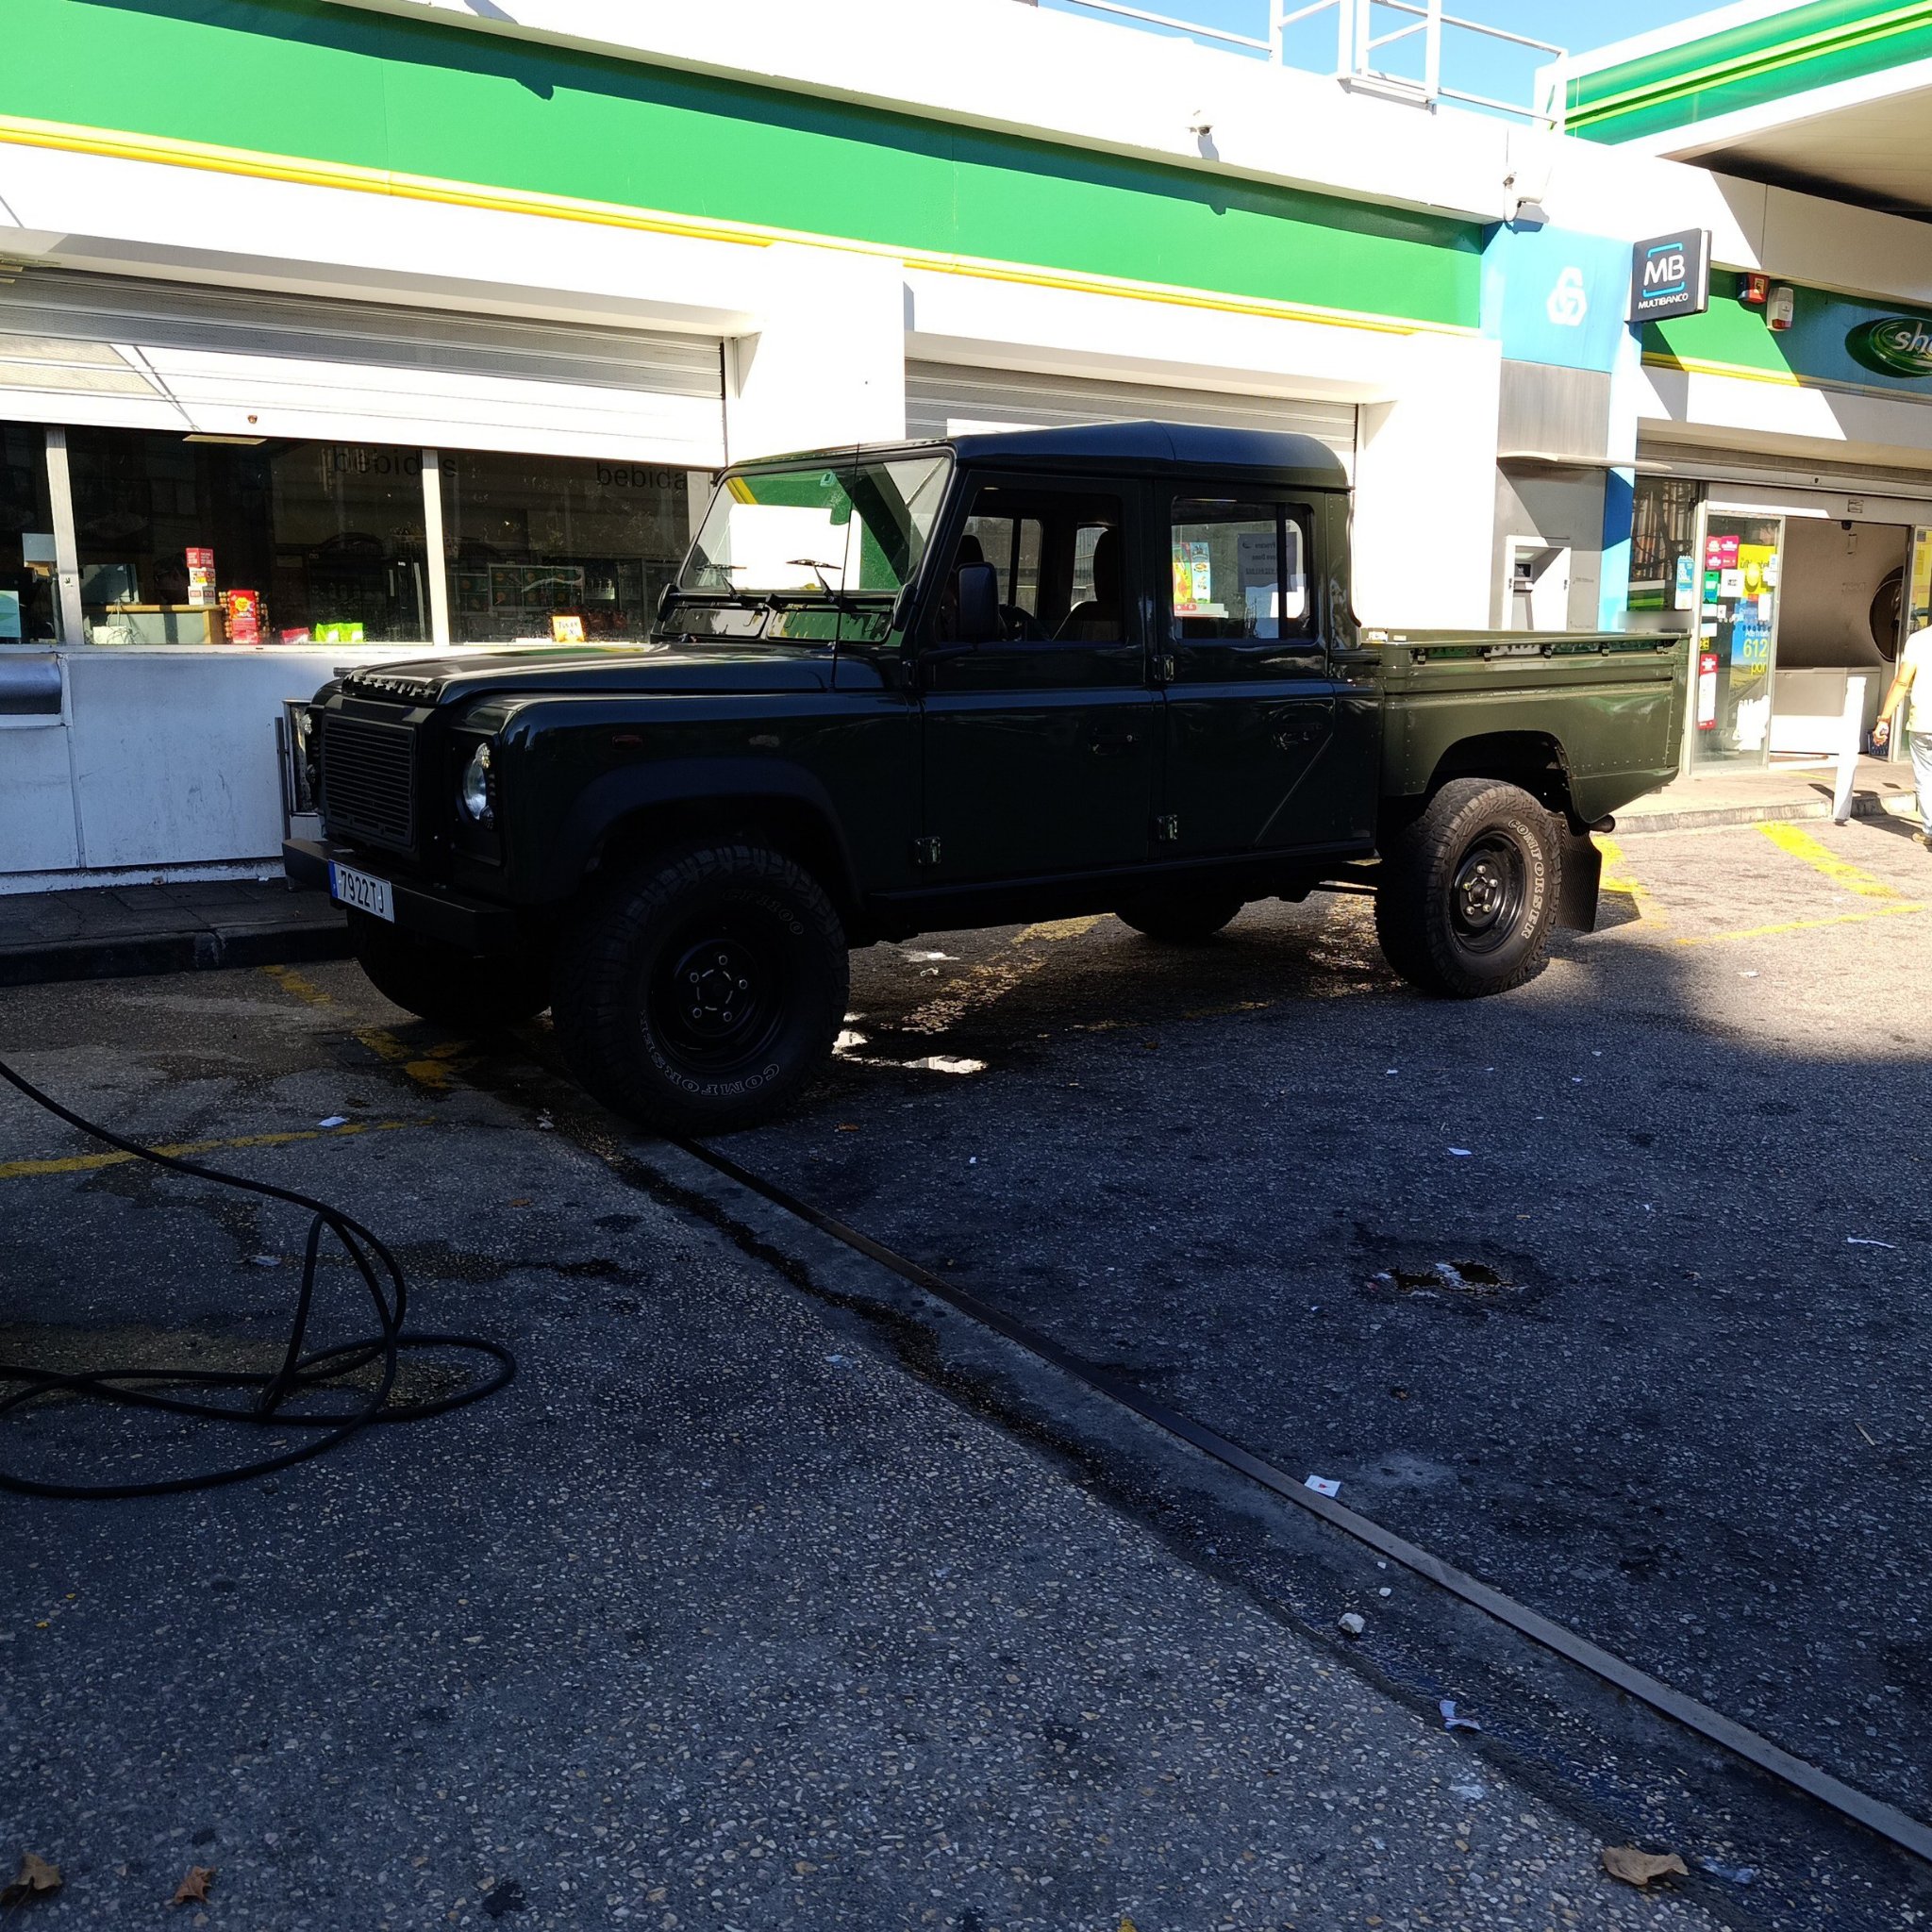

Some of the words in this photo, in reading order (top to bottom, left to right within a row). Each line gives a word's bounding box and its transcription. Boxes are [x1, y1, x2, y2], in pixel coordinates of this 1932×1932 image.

[1643, 254, 1686, 287] MB
[1638, 292, 1689, 310] MULTIBANCO
[1892, 320, 1932, 355] sh
[333, 444, 458, 478] bebids
[1742, 638, 1769, 658] 612
[1750, 661, 1767, 676] por
[341, 869, 385, 913] 7922TJ
[1507, 819, 1545, 940] COMFORSER
